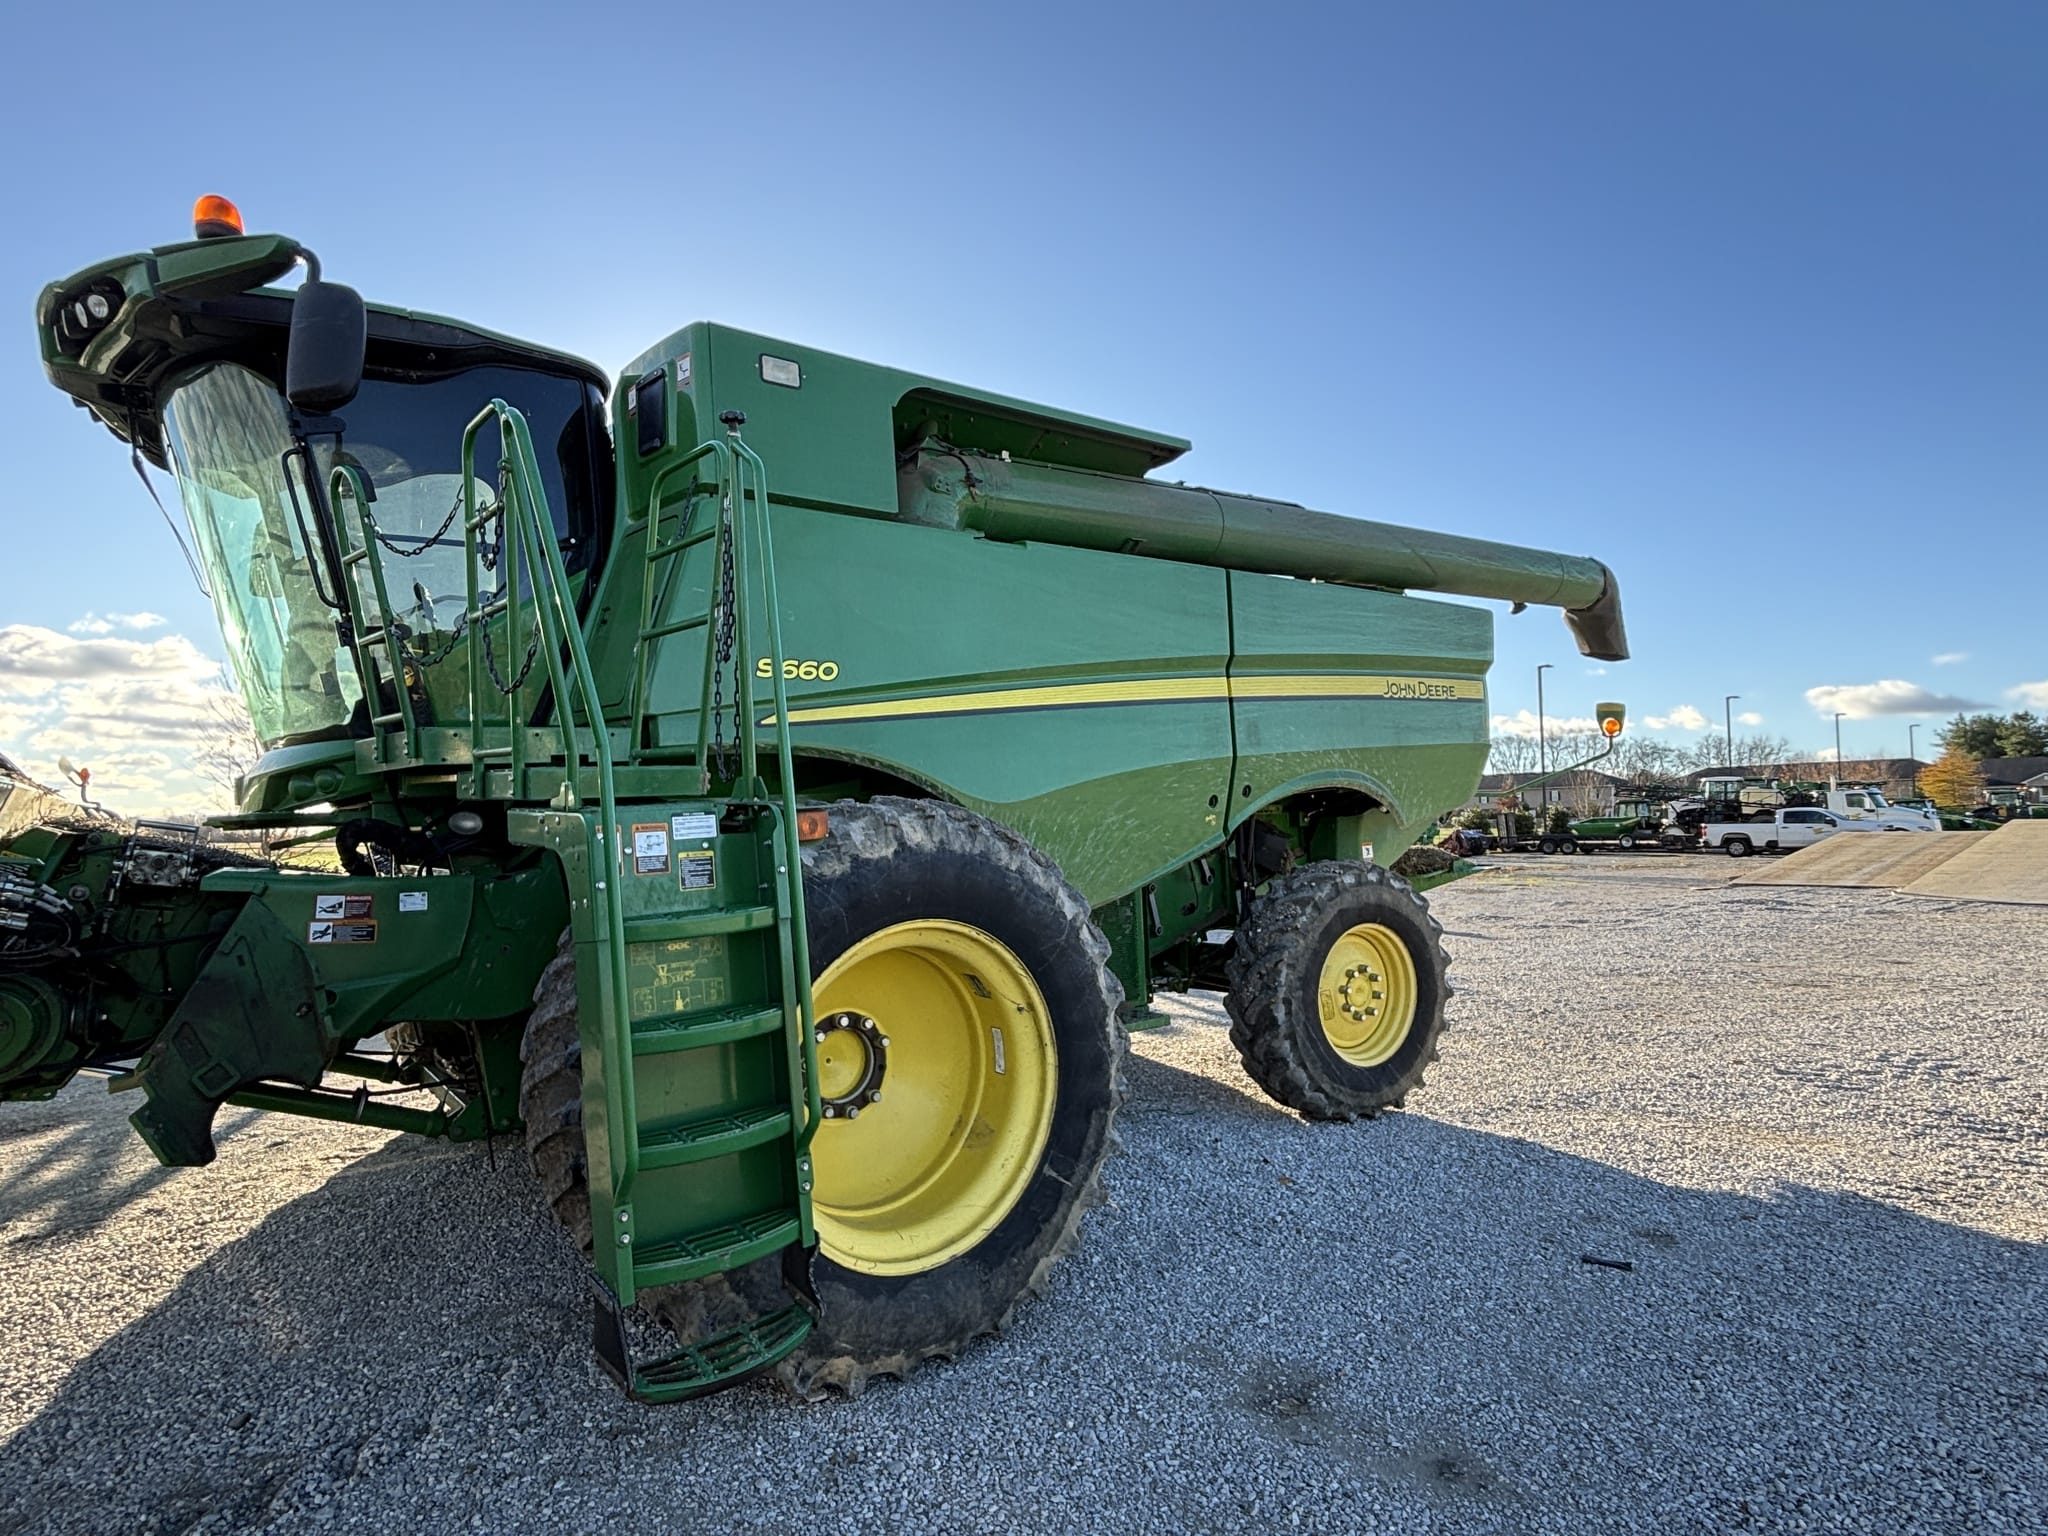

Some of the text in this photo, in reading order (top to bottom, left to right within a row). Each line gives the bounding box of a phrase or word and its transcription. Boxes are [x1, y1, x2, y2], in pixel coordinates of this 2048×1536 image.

[756, 657, 839, 681] S660
[1383, 680, 1456, 698] JOHN DEERE
